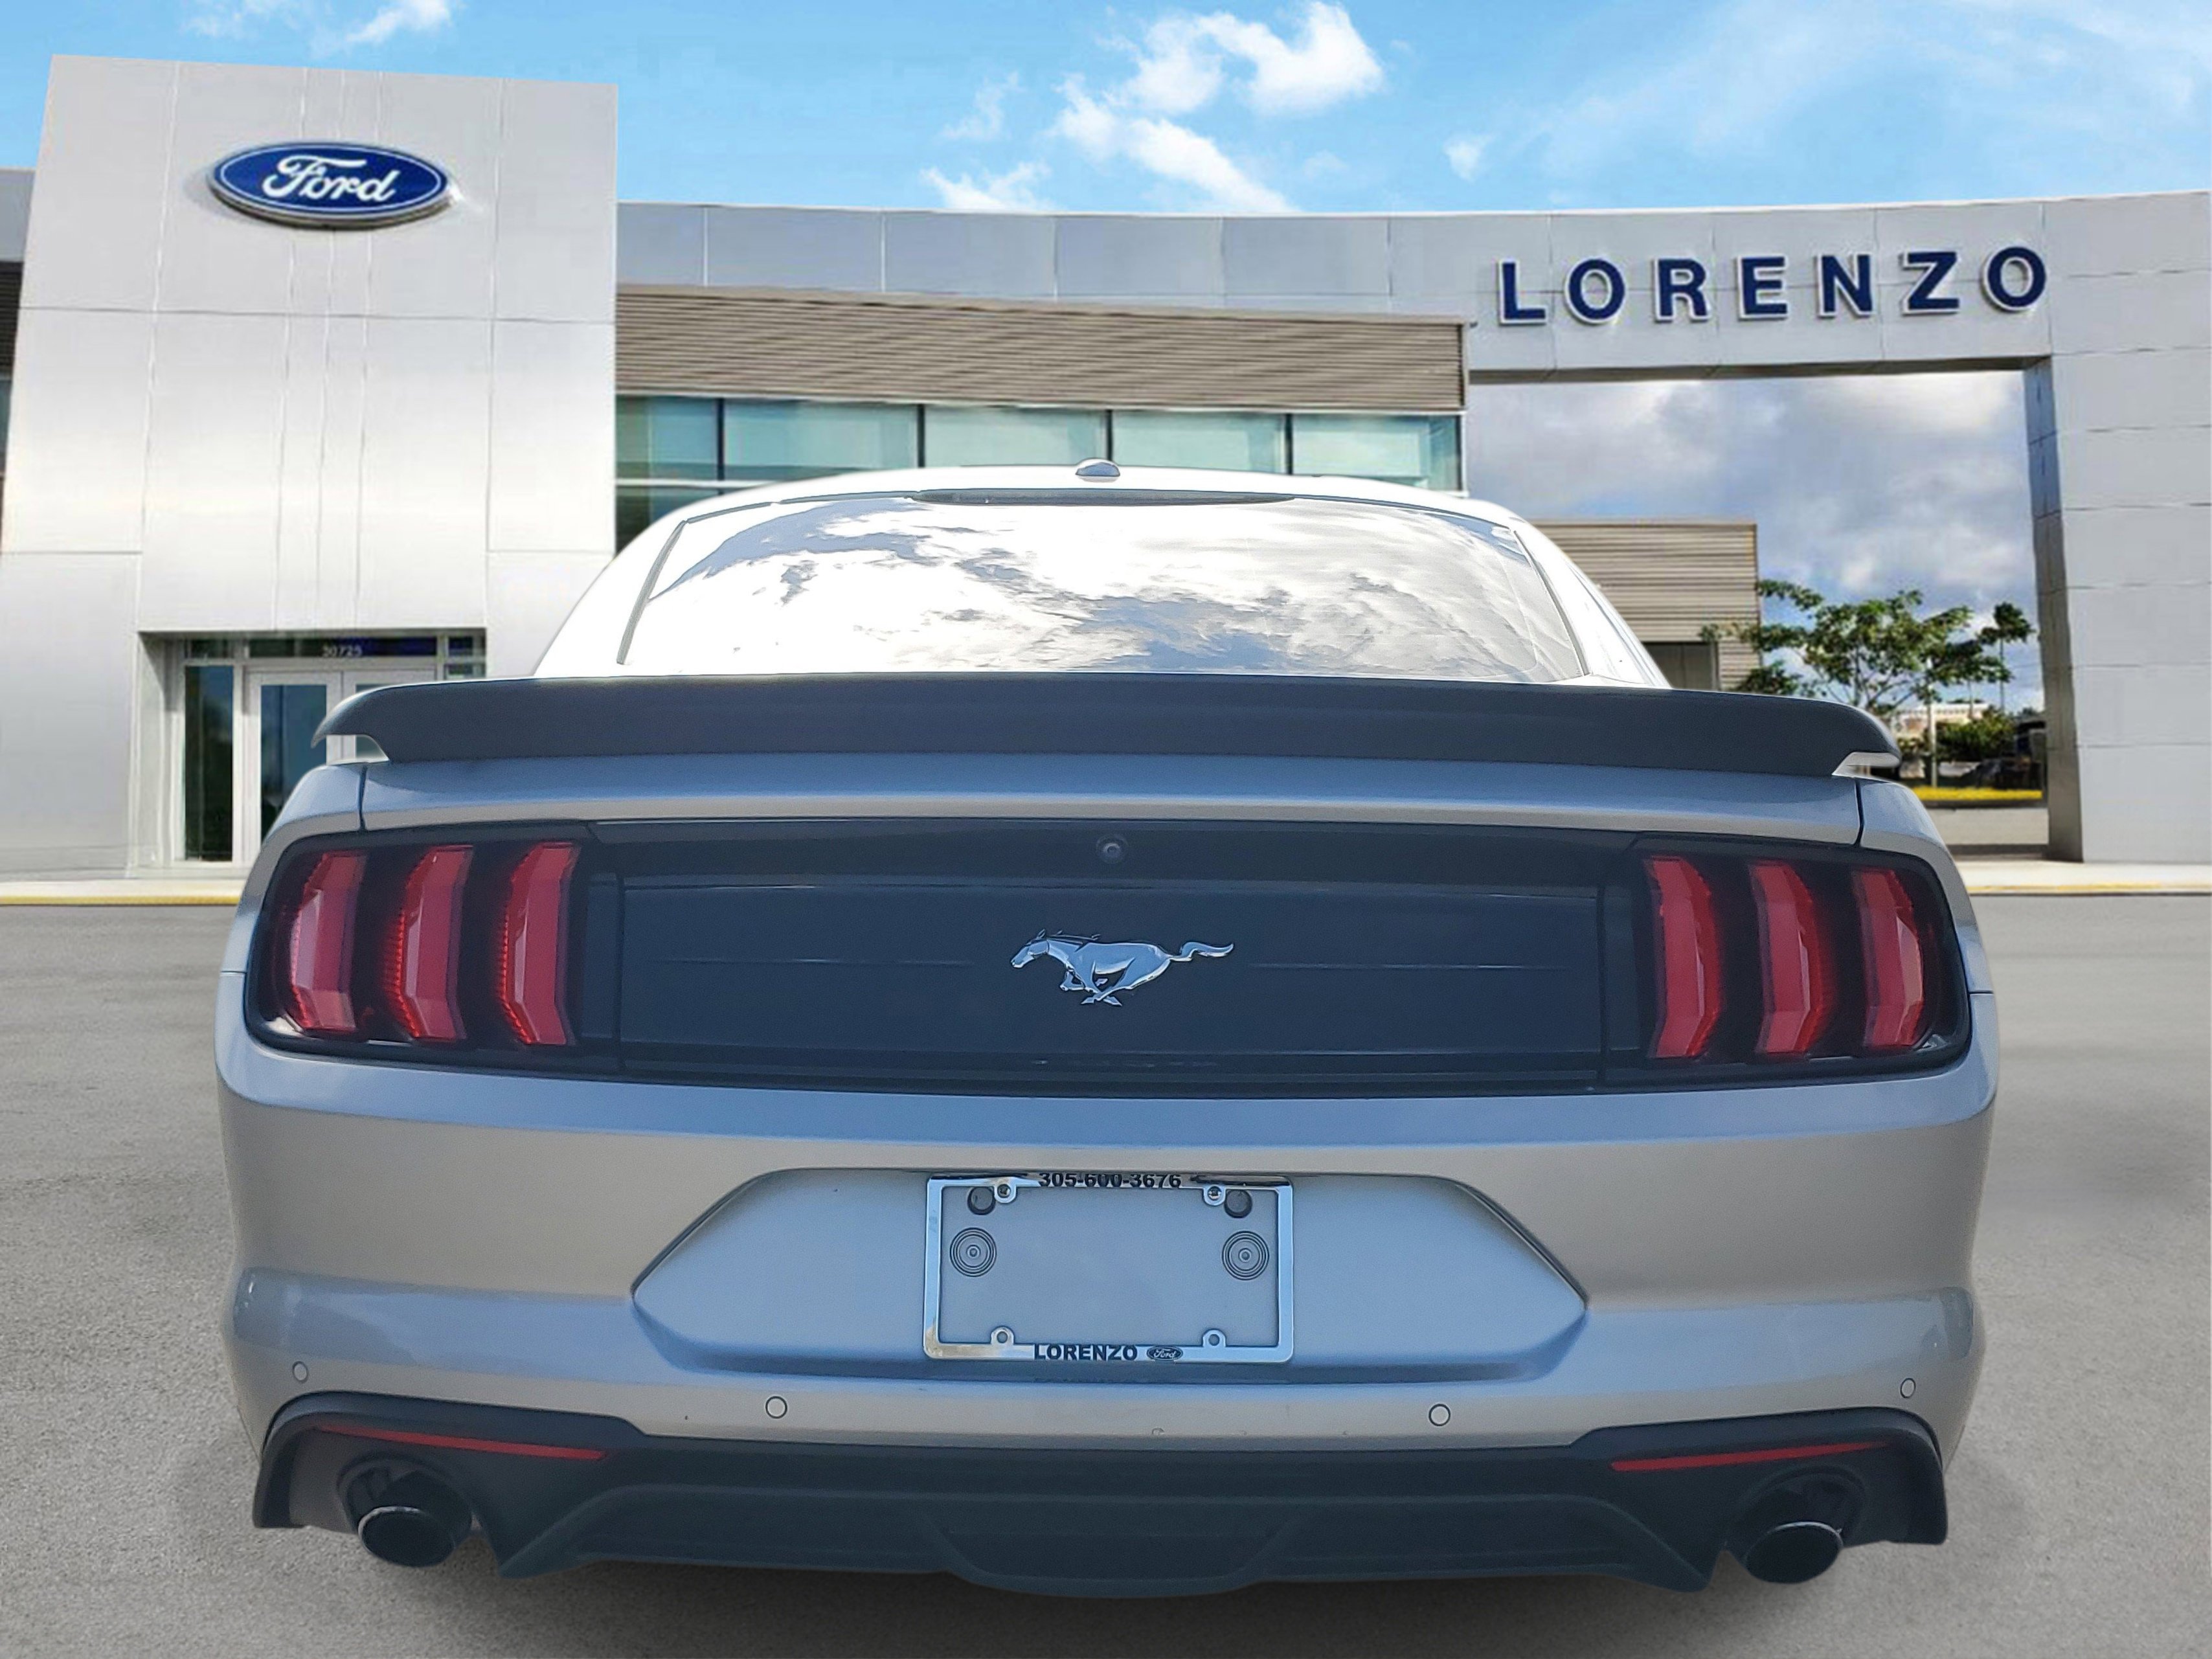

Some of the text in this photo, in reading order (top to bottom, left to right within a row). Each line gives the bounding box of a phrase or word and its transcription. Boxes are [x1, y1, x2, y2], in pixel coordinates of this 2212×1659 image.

[262, 155, 400, 202] Ford
[1500, 247, 2048, 323] LORENZO
[1039, 1173, 1182, 1189] 305-600-3676
[1035, 1344, 1177, 1361] LORENZO Ford
